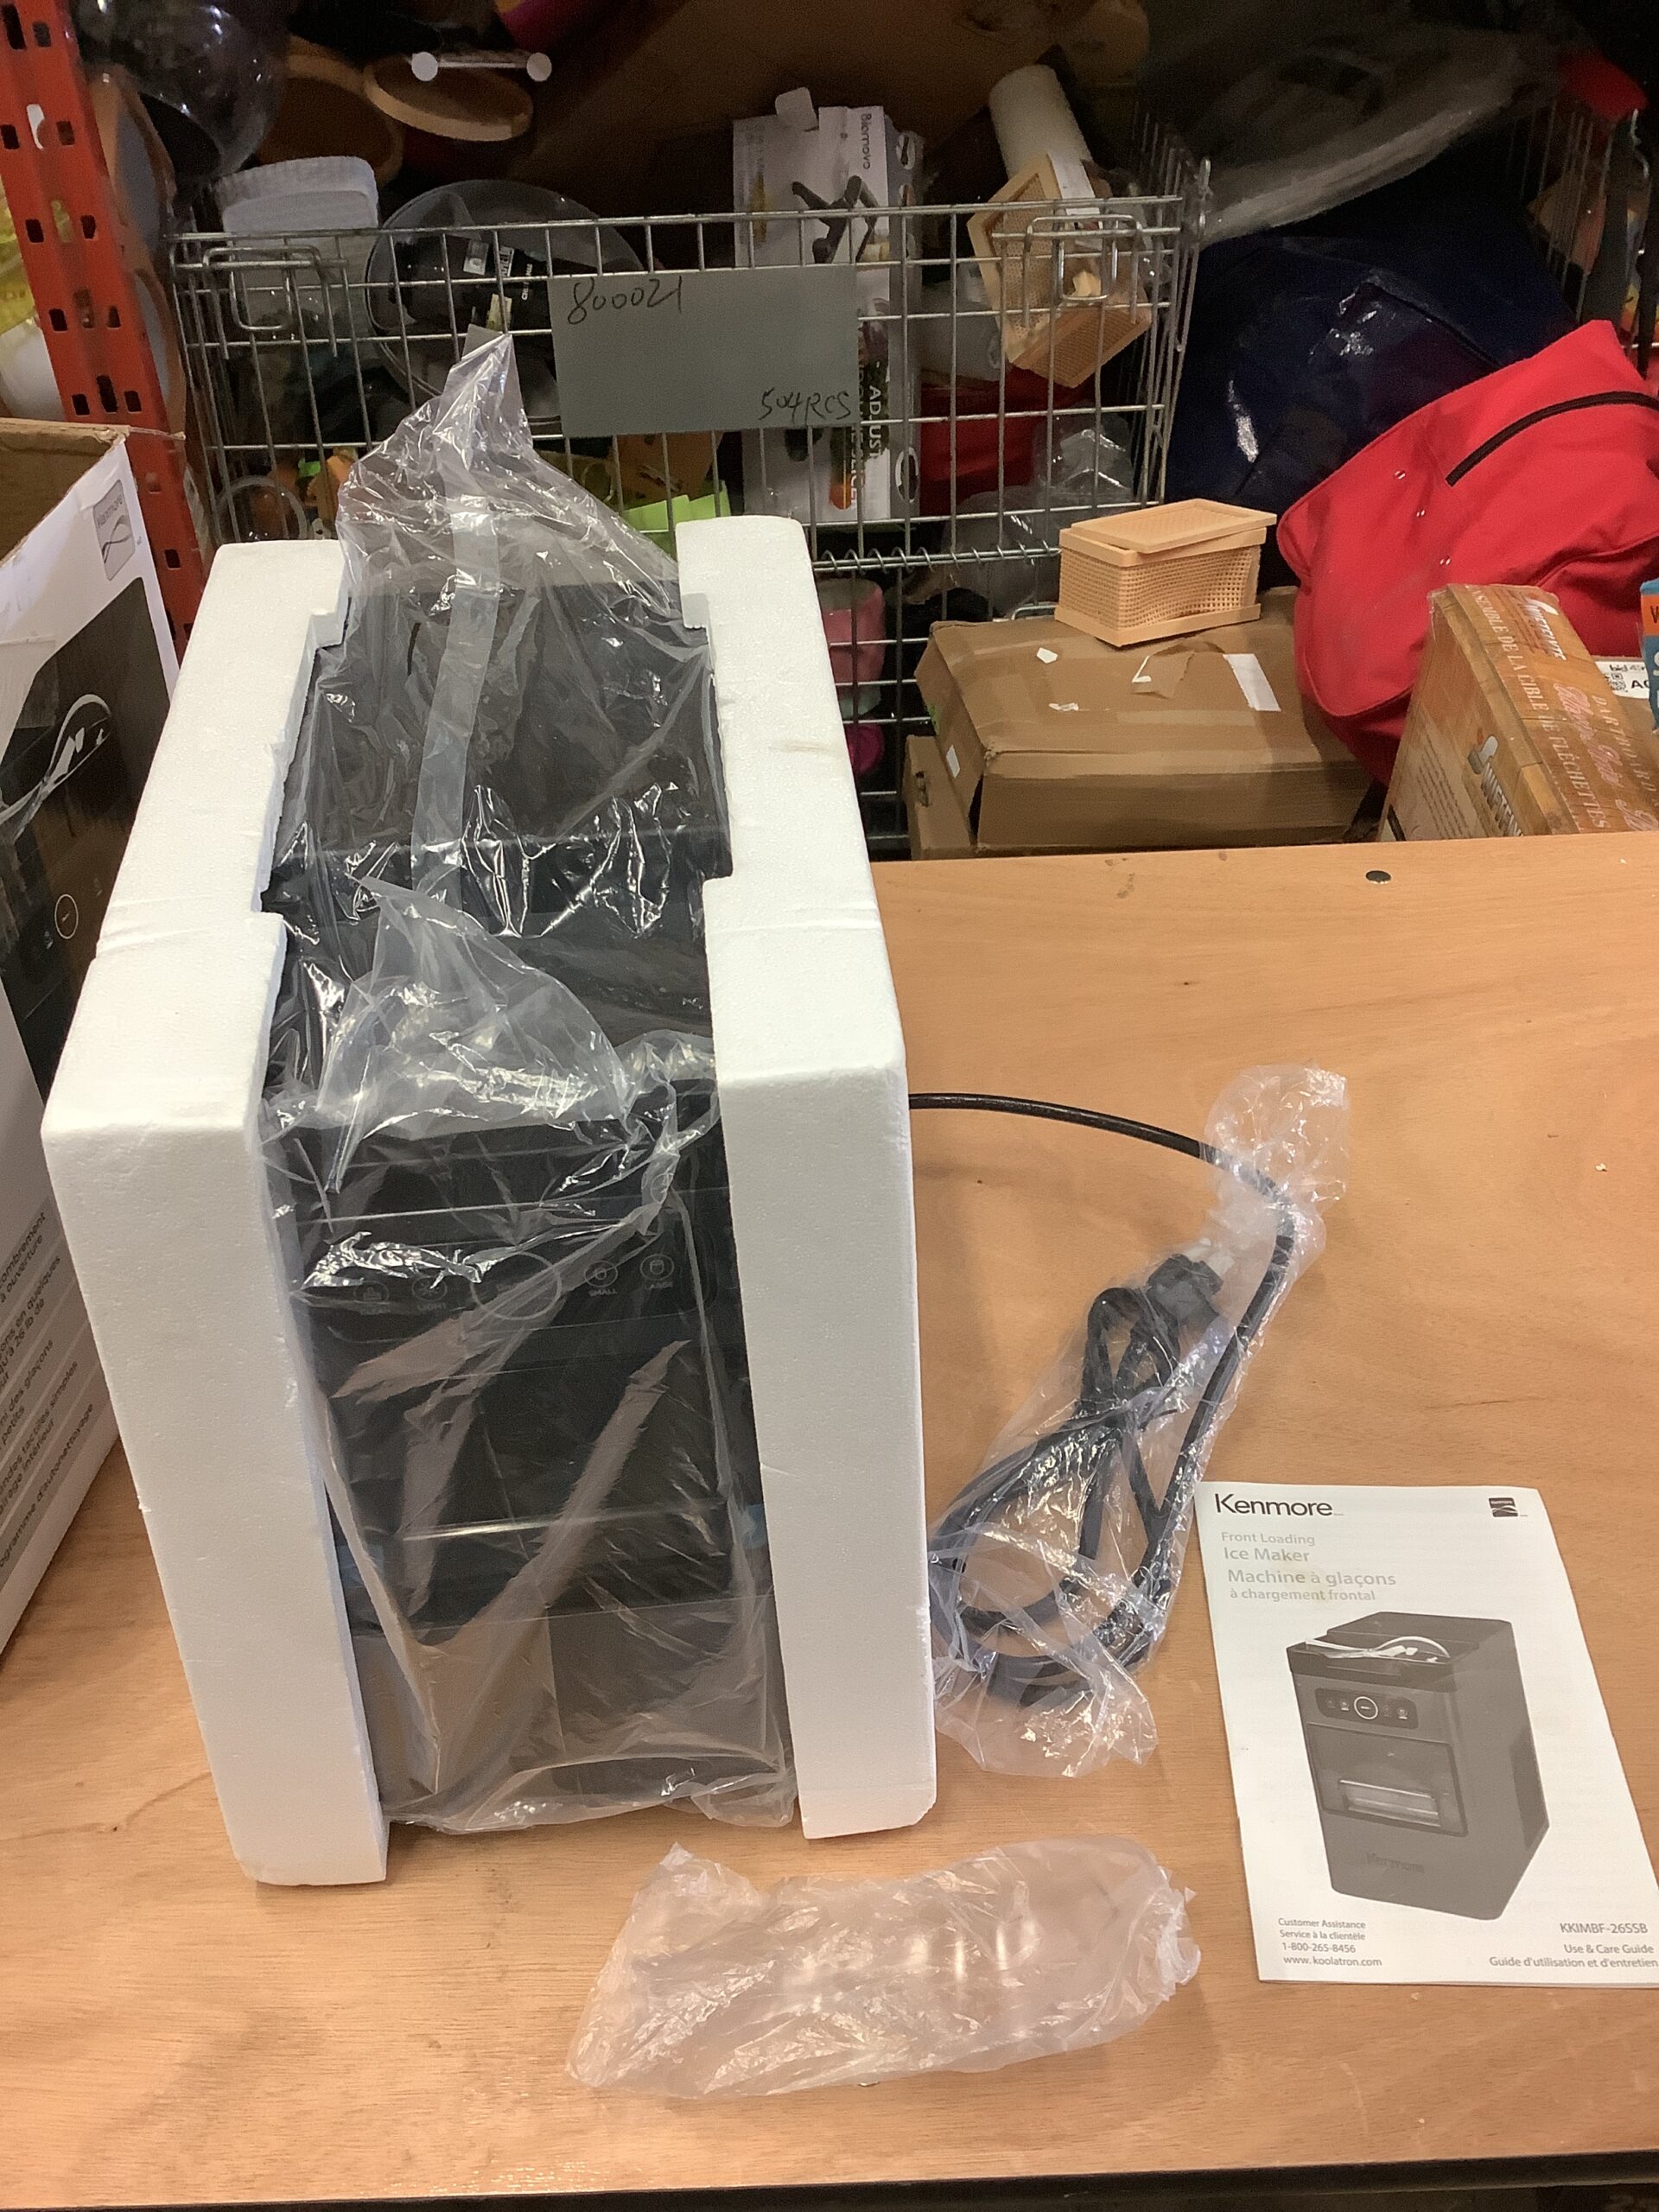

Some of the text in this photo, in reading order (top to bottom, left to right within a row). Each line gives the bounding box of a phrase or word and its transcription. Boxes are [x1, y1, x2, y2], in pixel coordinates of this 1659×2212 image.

[567, 275, 683, 326] 800021
[1497, 634, 1517, 652] DE
[1507, 653, 1526, 672] LA
[1517, 674, 1550, 713] CIBLE
[6, 1234, 43, 1294] ouverture
[15, 1309, 28, 1328] en
[26, 1255, 61, 1311] quelques
[33, 1297, 45, 1315] de
[8, 1389, 24, 1413] des
[23, 1338, 54, 1390] glaçons
[21, 1410, 51, 1455] tactiles
[48, 1360, 79, 1410] simples
[2, 1404, 26, 1446] petits
[1214, 1493, 1332, 1516] Kenmore
[1221, 1531, 1316, 1547] Front Loading
[1224, 1547, 1310, 1562] Ice Maker
[1228, 1569, 1397, 1588] Machine à glaçons
[1230, 1588, 1376, 1603] à chargement frontal
[1277, 1917, 1366, 1930] Customer Assistance
[1279, 1929, 1311, 1940] Service
[1319, 1930, 1328, 1940] la
[1328, 1931, 1366, 1942] clientèle
[1281, 1942, 1357, 1954] 1-800-265-8456
[1563, 1943, 1655, 1955] Use & Care Guide
[1489, 1956, 1659, 1968] Guide d'utilisation et d'entretien
